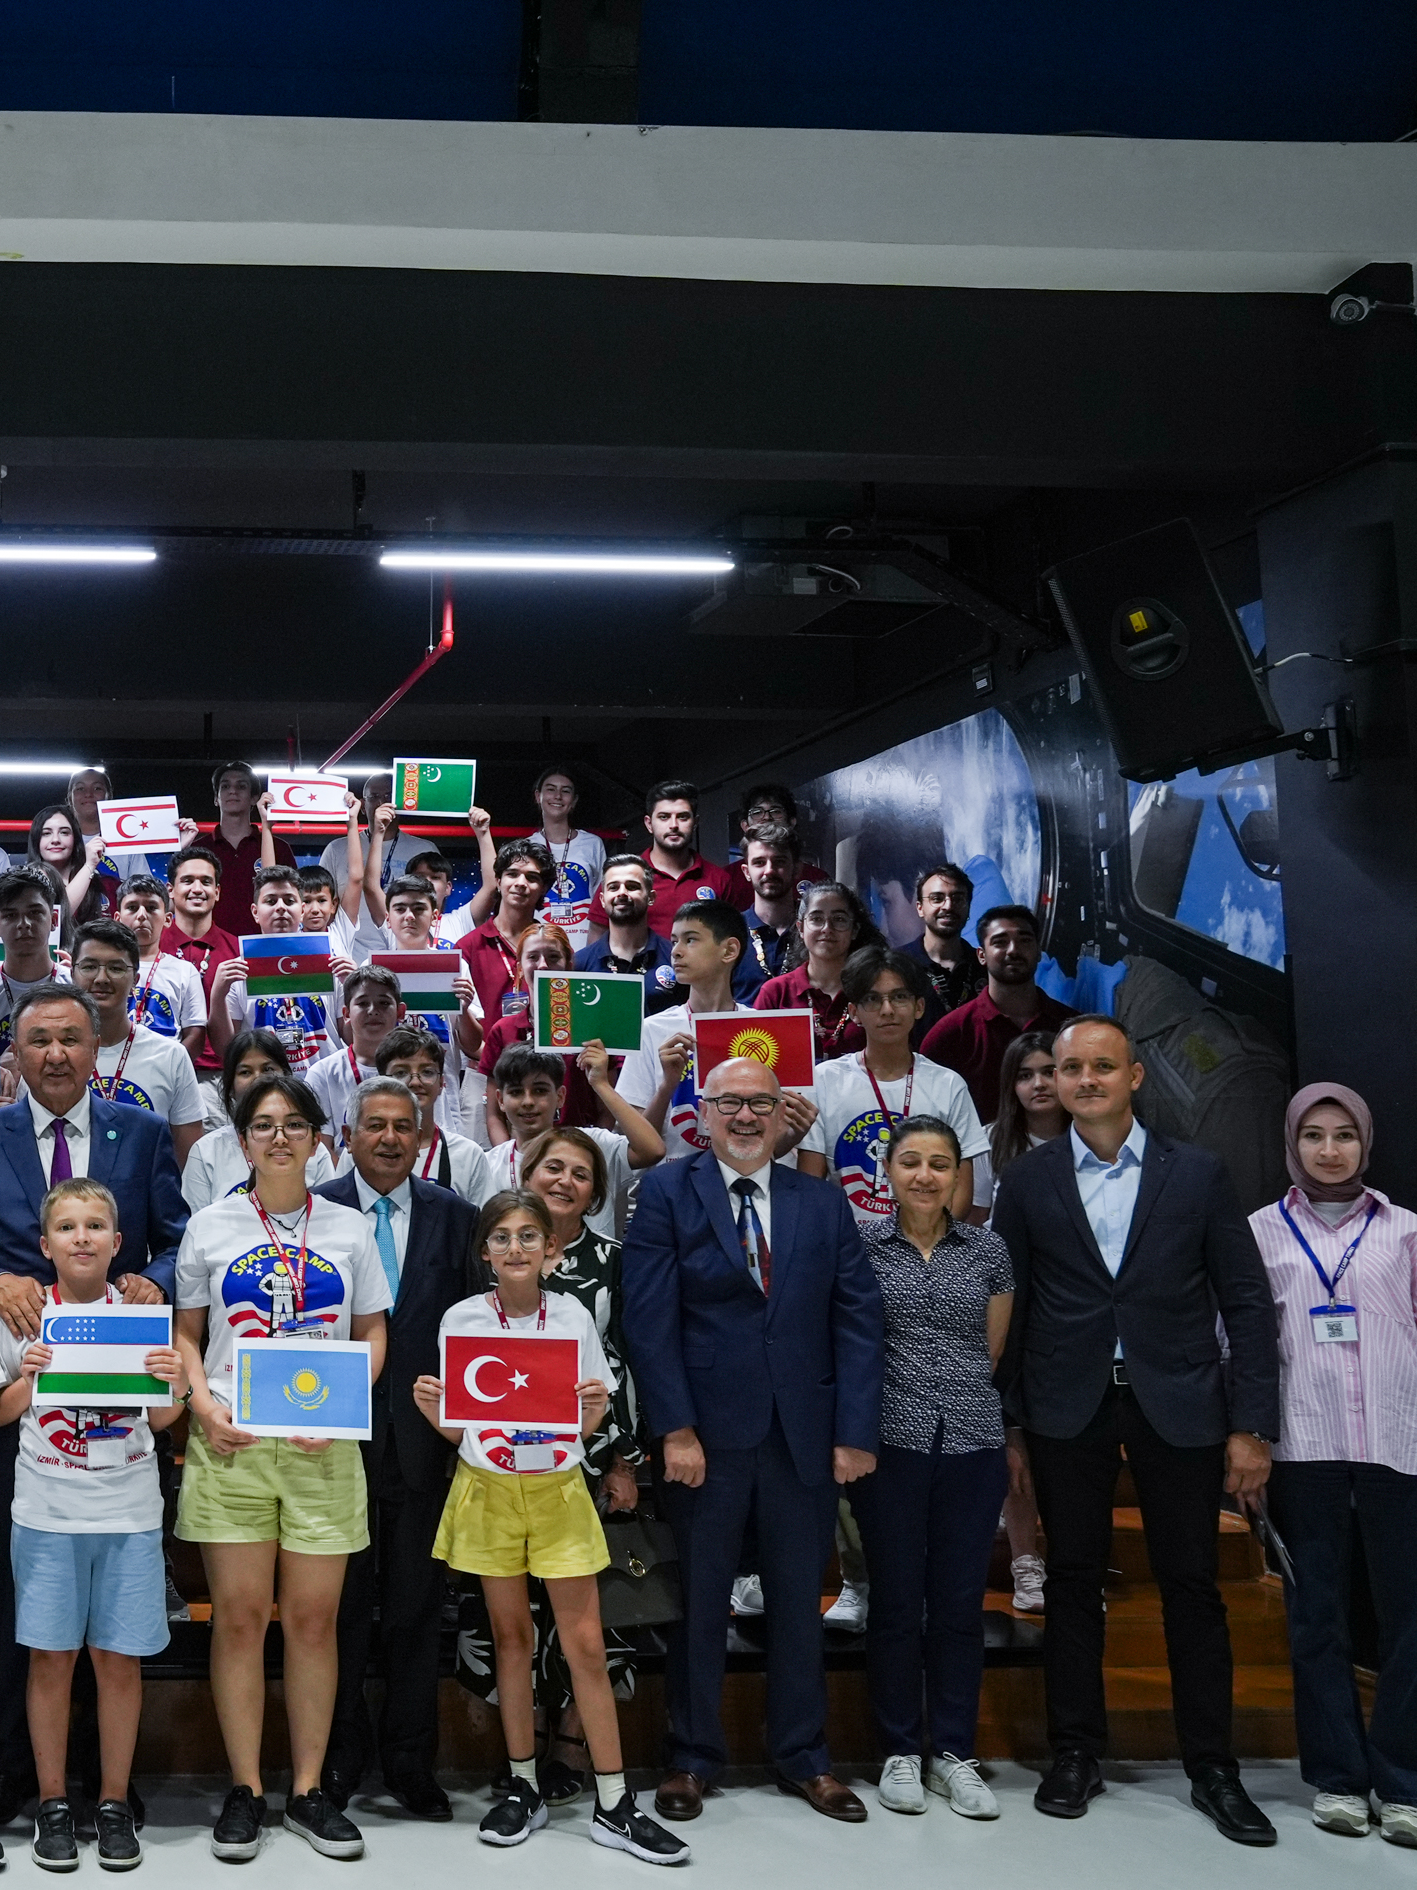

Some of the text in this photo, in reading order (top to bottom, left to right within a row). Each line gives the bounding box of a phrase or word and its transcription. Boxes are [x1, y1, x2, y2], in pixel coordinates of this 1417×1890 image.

[145, 990, 172, 1017] CAMP
[286, 1048, 311, 1060] RKİYE
[117, 1080, 150, 1110] CAMP
[842, 1112, 884, 1143] SPACE
[232, 1246, 280, 1276] SPACE
